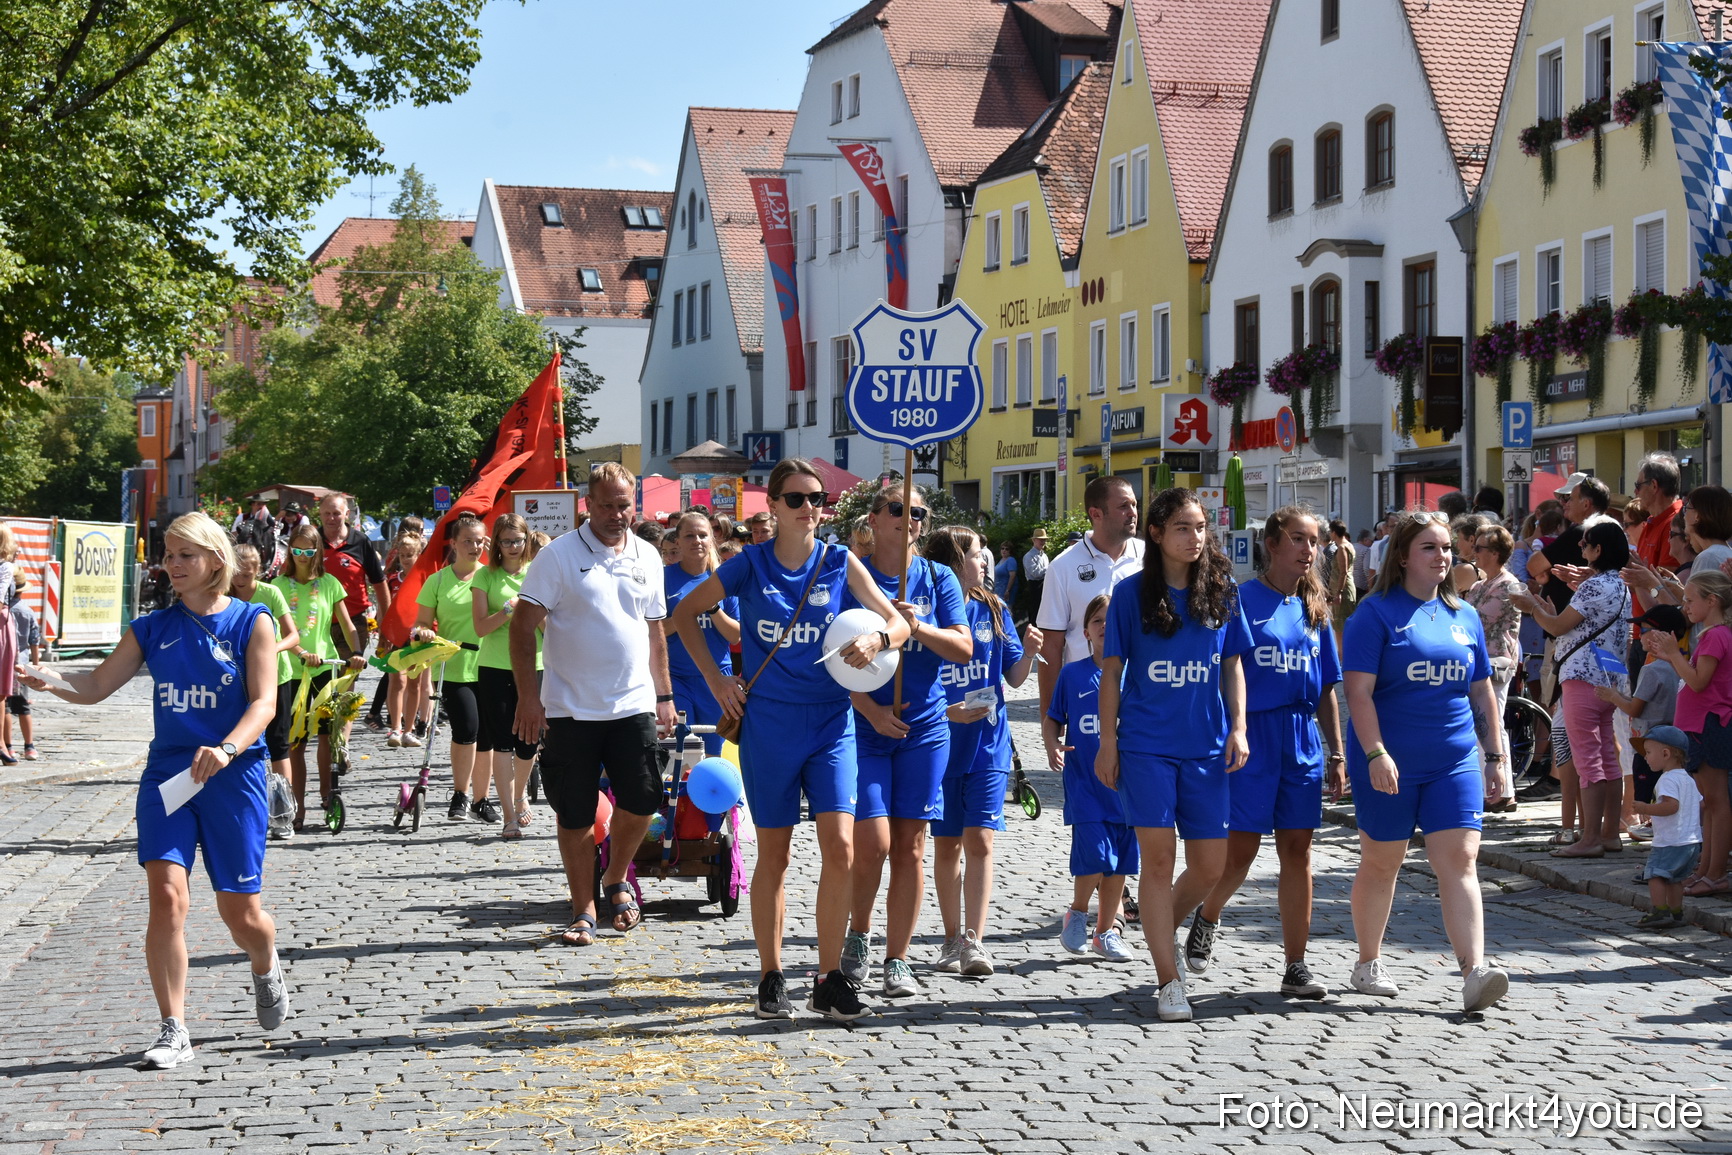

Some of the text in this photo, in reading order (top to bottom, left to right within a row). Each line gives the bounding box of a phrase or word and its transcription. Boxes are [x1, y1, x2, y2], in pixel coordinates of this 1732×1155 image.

[1000, 293, 1072, 330] HOTEL Lehmeier
[898, 328, 938, 361] SV
[871, 368, 963, 403] STAUF
[1568, 378, 1586, 393] MEHR
[890, 407, 938, 428] 1980
[1035, 425, 1073, 435] TAIFN
[1110, 412, 1137, 431] AIFUN
[1509, 407, 1526, 443] P
[996, 439, 1039, 461] Restaurant
[757, 619, 821, 649] Elyth
[939, 658, 990, 688] Elyth
[1147, 660, 1210, 688] Elyth
[1253, 645, 1310, 674] Elyth
[1406, 659, 1467, 686] Elyth
[158, 682, 217, 713] Elyth
